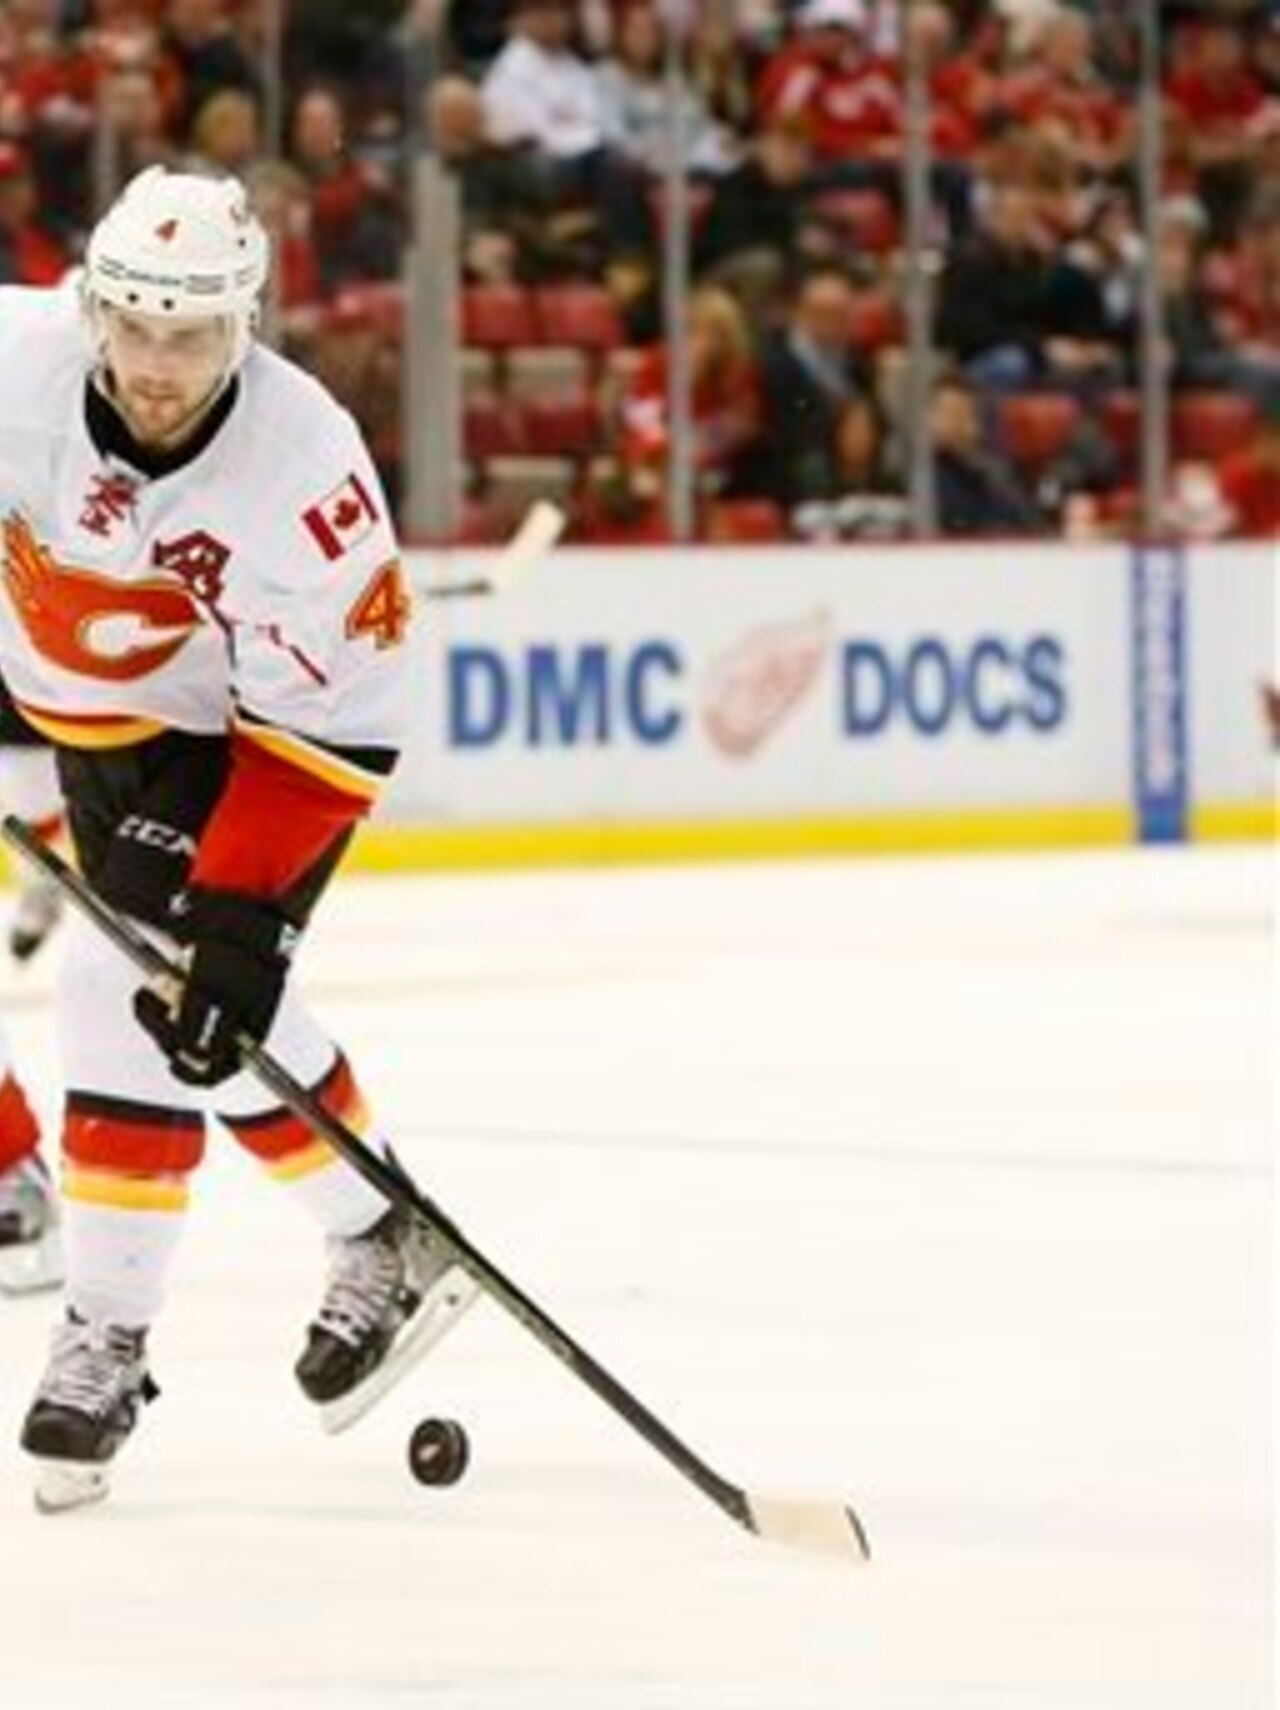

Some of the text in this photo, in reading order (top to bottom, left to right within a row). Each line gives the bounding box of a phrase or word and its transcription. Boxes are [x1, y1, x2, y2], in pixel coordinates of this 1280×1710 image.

[154, 218, 179, 241] 4
[345, 556, 411, 651] 4
[447, 640, 684, 750] DMC
[840, 634, 1070, 740] DOCS
